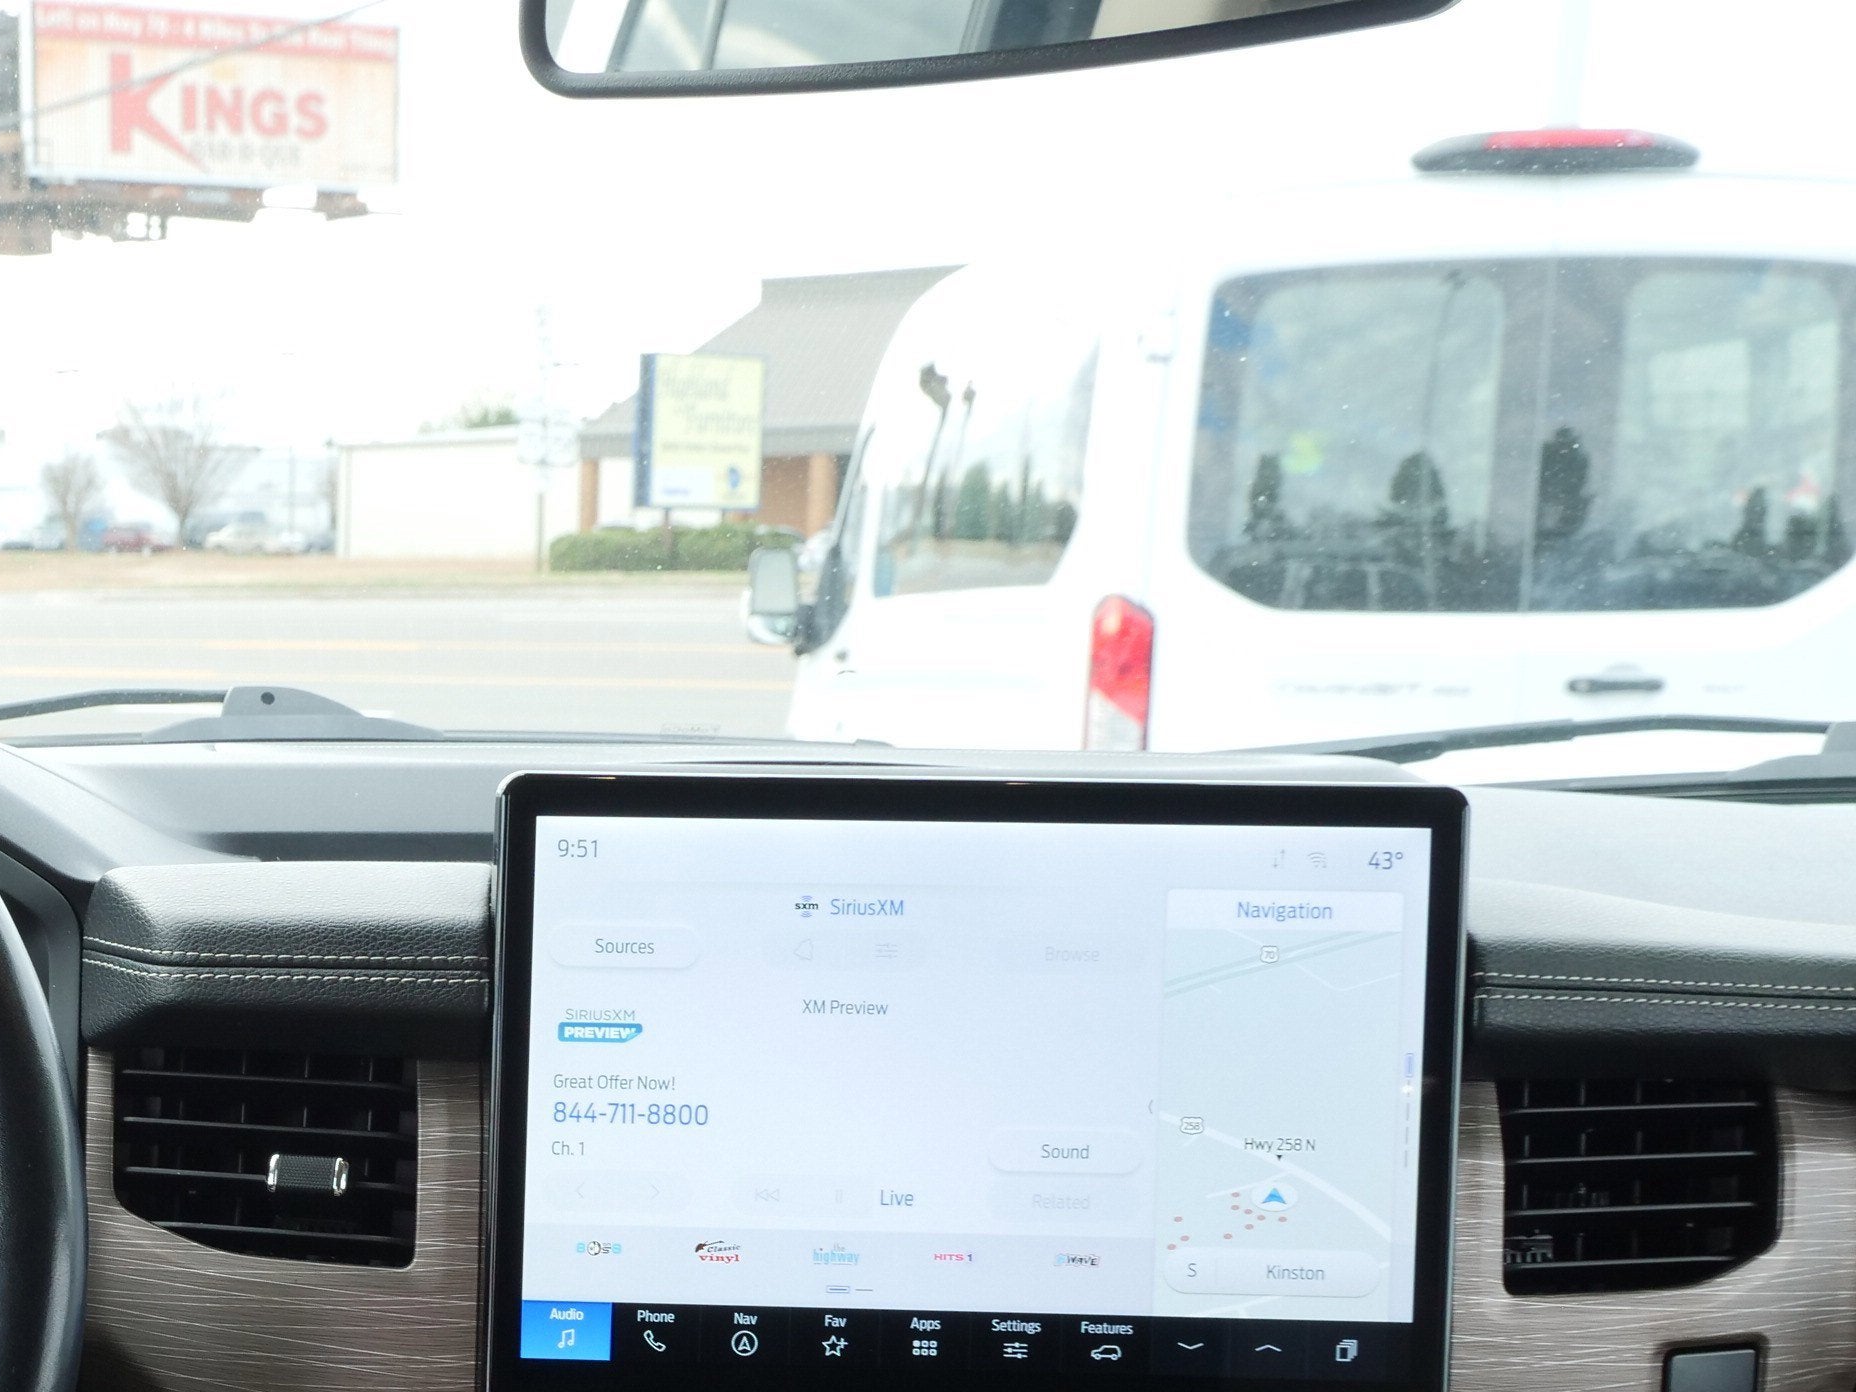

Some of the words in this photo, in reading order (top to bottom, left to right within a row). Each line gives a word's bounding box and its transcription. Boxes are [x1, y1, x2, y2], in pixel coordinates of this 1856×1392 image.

[111, 53, 328, 173] KINGS
[556, 839, 600, 859] 9:51
[1368, 851, 1404, 870] 43°
[830, 898, 904, 917] SiriusXM
[1237, 901, 1333, 922] Navigation
[595, 938, 655, 955] Sources
[565, 1008, 635, 1021] SIRIUSXM
[802, 1000, 827, 1015] XM
[830, 1000, 889, 1019] Preview
[564, 1026, 637, 1040] PREVIEW
[553, 1074, 593, 1090] Great
[597, 1074, 634, 1091] Offer
[637, 1076, 676, 1091] Now!
[553, 1101, 709, 1126] 844-711-8800
[551, 1141, 575, 1156] Ch.
[579, 1142, 585, 1156] 1
[1041, 1144, 1090, 1160] Sound
[1244, 1137, 1275, 1154] Hwy
[1277, 1138, 1303, 1152] 258
[1306, 1138, 1316, 1152] N
[880, 1189, 914, 1207] Live
[1032, 1193, 1090, 1211] Related
[698, 1253, 741, 1264] vinyl
[812, 1248, 860, 1265] highway
[933, 1253, 964, 1262] HITS
[967, 1253, 973, 1262] 1
[1187, 1263, 1197, 1278] S
[1266, 1264, 1325, 1281] Kinston
[549, 1308, 584, 1321] Audio
[637, 1310, 675, 1324] Phone
[733, 1313, 758, 1326] Nav
[824, 1315, 847, 1328] Fav
[910, 1317, 941, 1332] Apps
[991, 1319, 1042, 1336] Settings
[1080, 1321, 1133, 1335] Features
